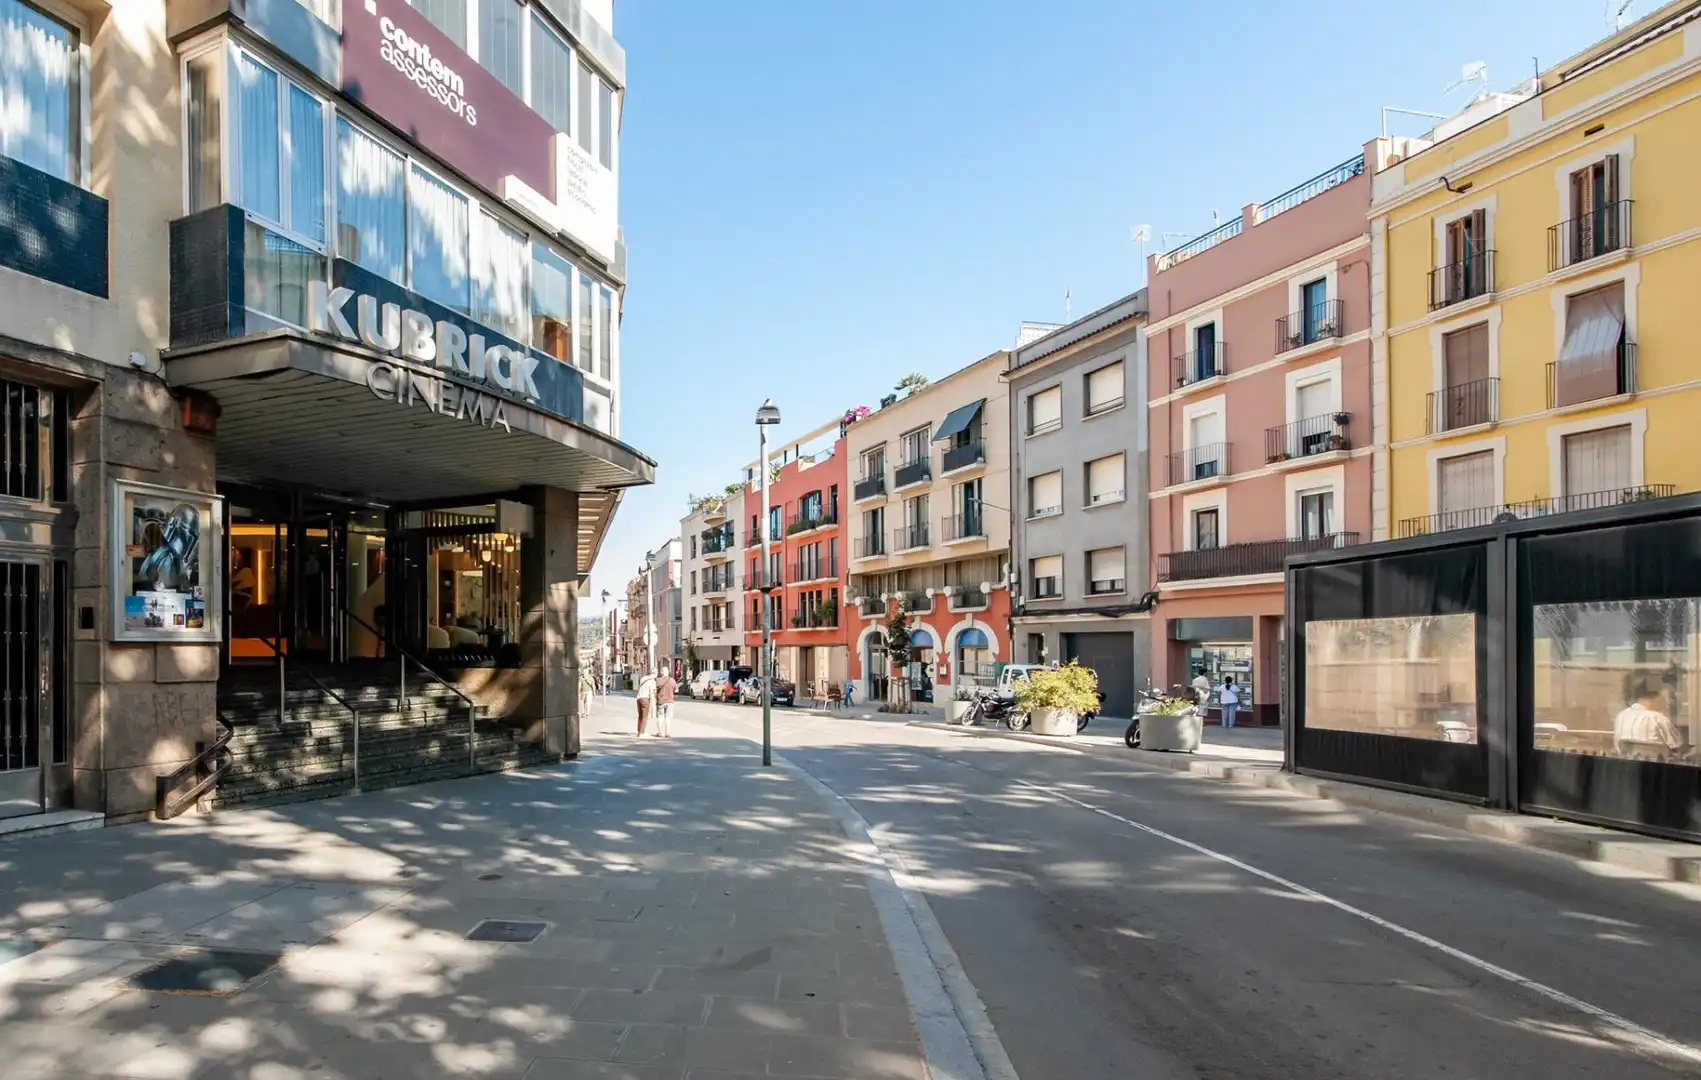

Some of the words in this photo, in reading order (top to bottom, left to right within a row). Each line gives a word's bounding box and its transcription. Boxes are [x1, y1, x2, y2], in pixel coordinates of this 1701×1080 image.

[380, 16, 464, 97] contem
[380, 39, 477, 125] assessors
[308, 279, 540, 400] KUBRICK
[366, 362, 511, 434] CINEMA
